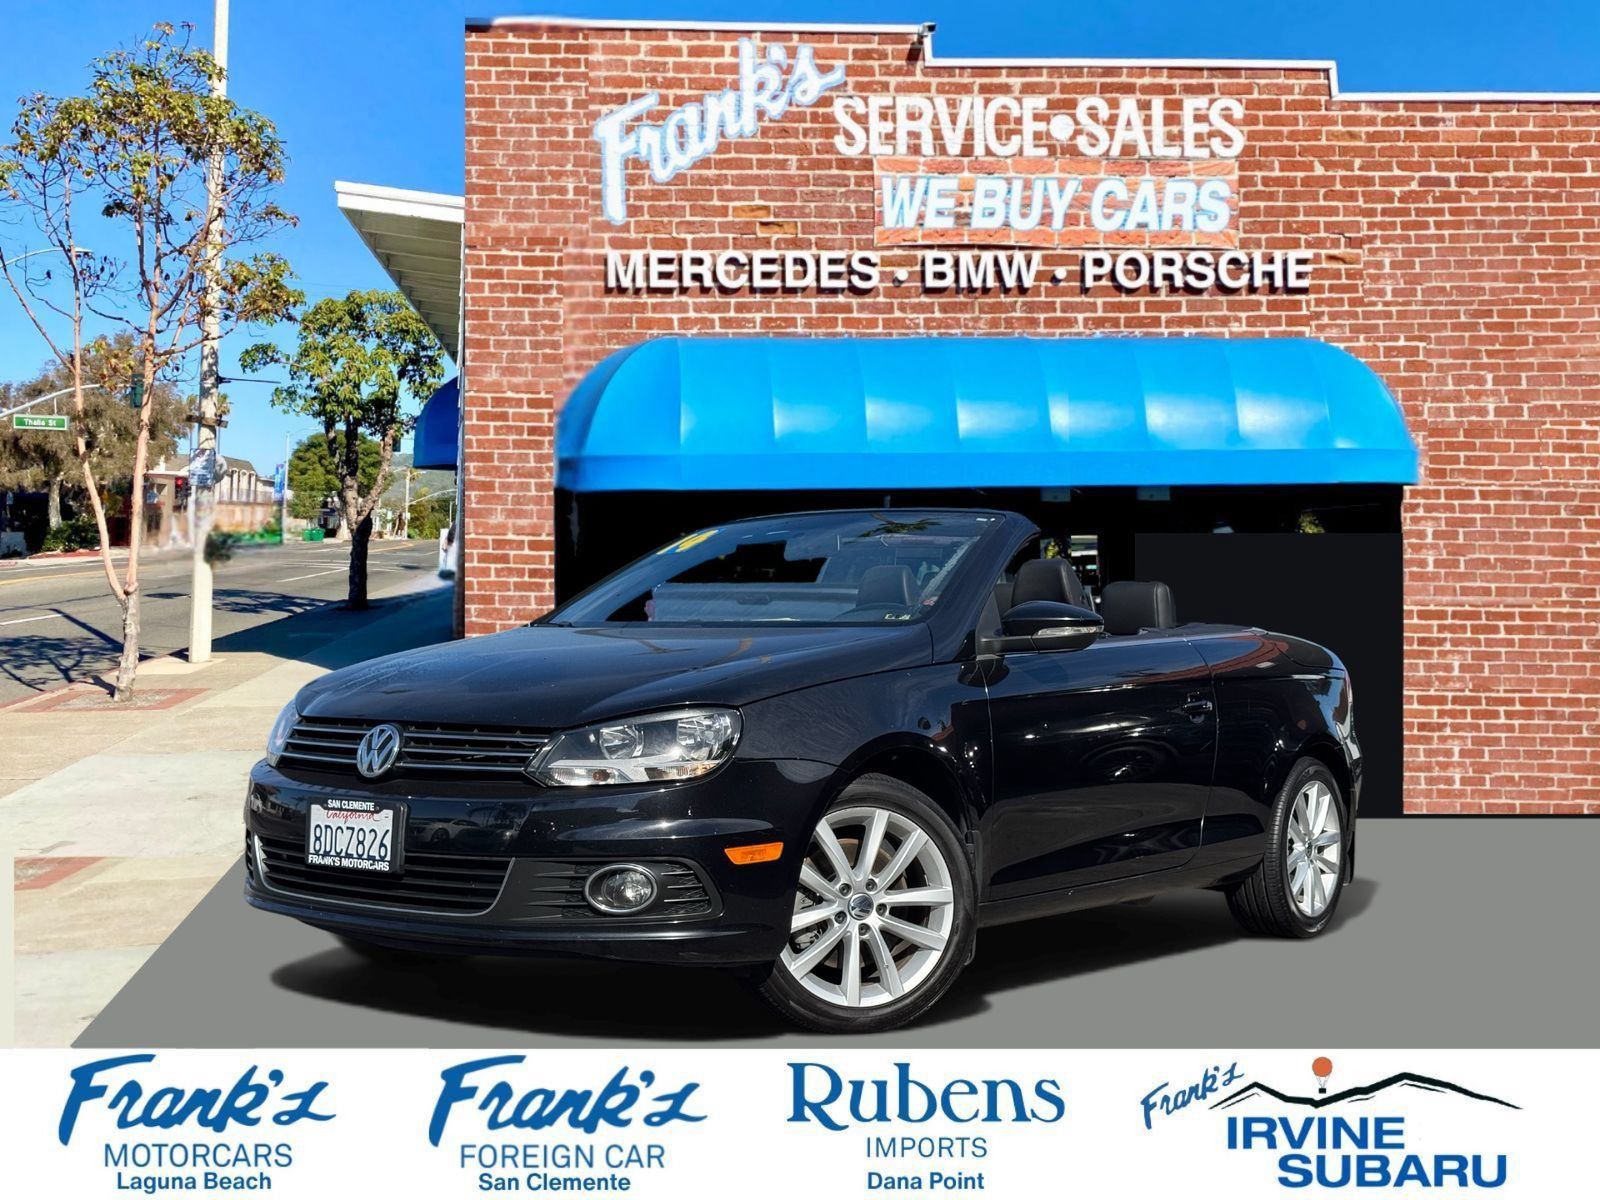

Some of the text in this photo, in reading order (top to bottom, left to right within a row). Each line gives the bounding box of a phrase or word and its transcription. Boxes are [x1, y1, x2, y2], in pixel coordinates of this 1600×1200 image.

[593, 37, 845, 225] Frank's
[881, 175, 1234, 234] WE BUY CARS
[605, 250, 1313, 291] MERCEDES BMW PORSCHE
[48, 418, 57, 426] St
[328, 799, 375, 811] SAN CLEMENTE
[313, 823, 390, 860] 8DCZ826
[308, 855, 390, 871] FRANK'S MOTORCARS
